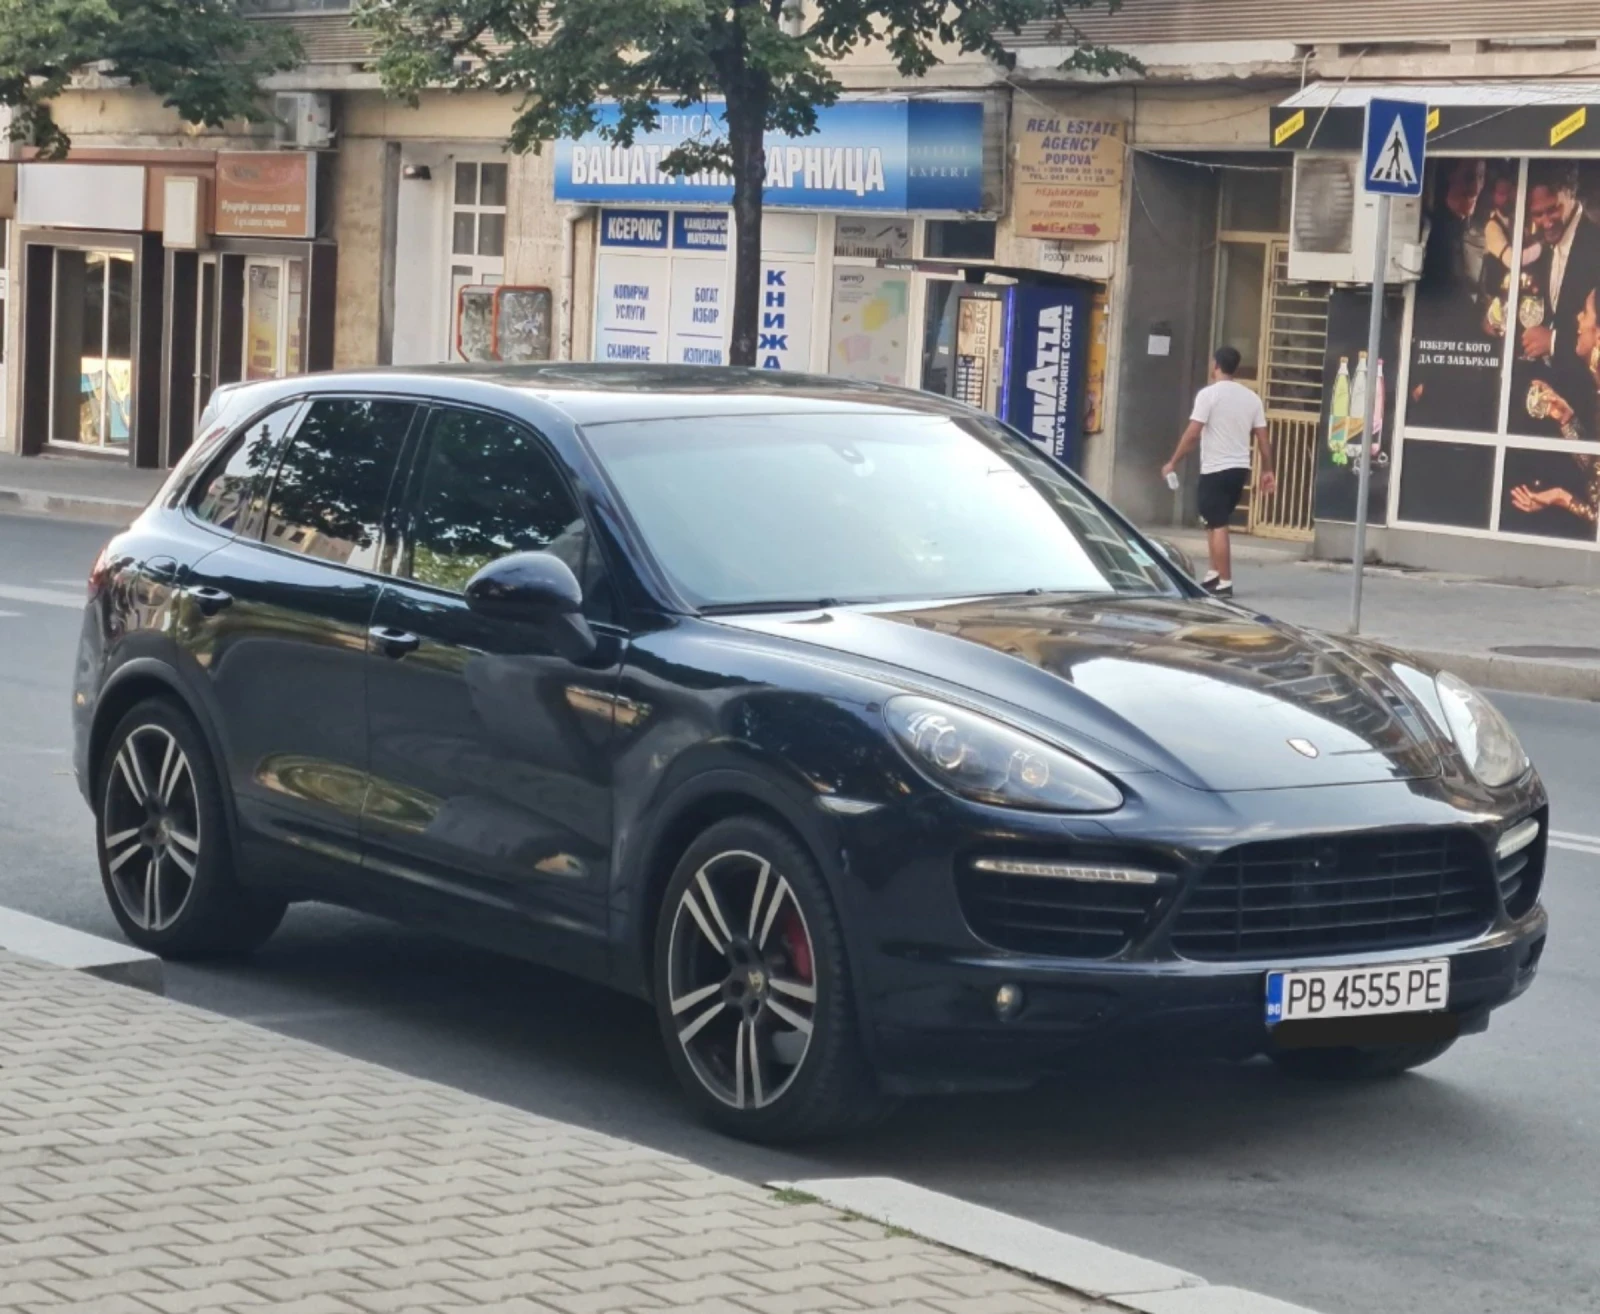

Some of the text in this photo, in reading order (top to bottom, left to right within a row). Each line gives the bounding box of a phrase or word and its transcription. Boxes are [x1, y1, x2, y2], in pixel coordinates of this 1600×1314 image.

[655, 114, 712, 135] FFICE
[1026, 118, 1118, 136] REAL ESTATE
[1041, 136, 1100, 151] AGENCY
[909, 166, 971, 178] EXPERT
[608, 217, 662, 241] КСЕРОКС
[684, 217, 728, 233] КАНЦЕЛАРС
[613, 284, 650, 301] КОПИРНИ
[695, 287, 720, 303] БОГАТ
[616, 304, 646, 321] УСЛУГИ
[692, 308, 720, 323] ИЗБОР
[607, 343, 651, 361] СКАНИРАНЕ
[1419, 341, 1492, 353] ИЗБЕРИ С КОГО
[1418, 354, 1499, 366] ДА СЕ ЗАБЪРКАШ
[1055, 305, 1073, 456] ITALY'S FAVOURITE COFFEE
[1288, 968, 1443, 1015] PB 4555 PE
[1268, 1003, 1281, 1015] BG
